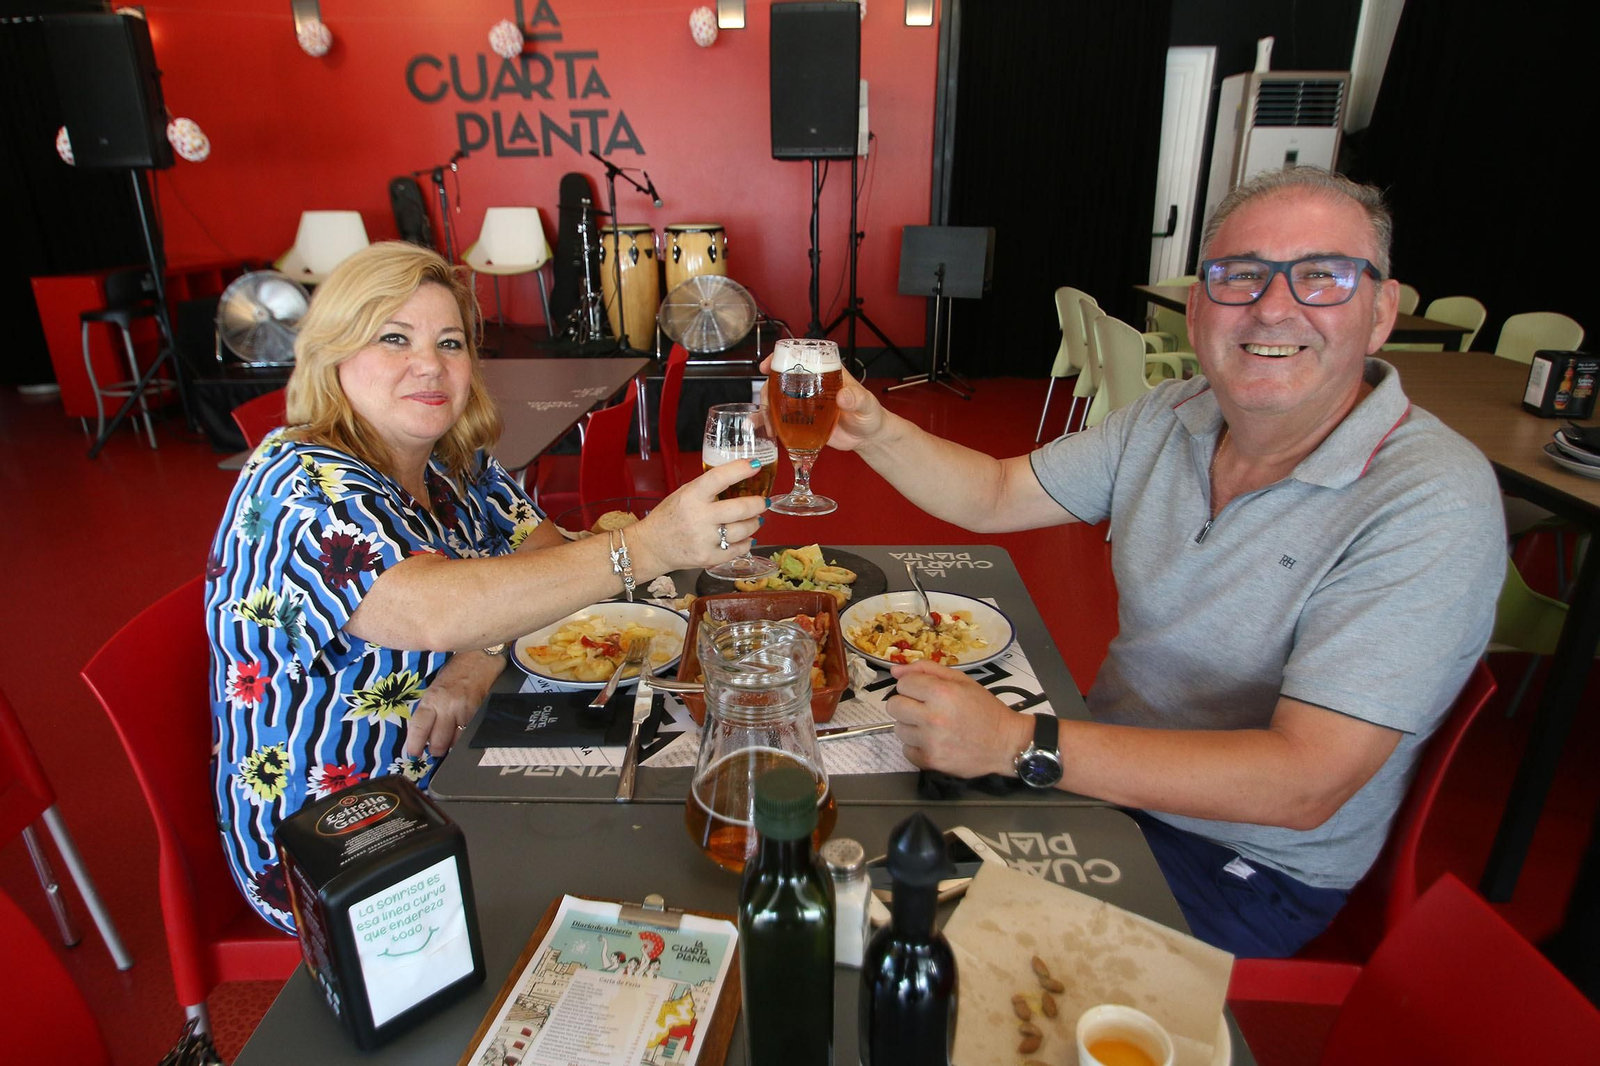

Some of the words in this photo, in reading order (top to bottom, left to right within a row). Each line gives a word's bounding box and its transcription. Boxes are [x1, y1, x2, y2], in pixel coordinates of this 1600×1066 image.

[514, 0, 562, 41] LA
[405, 50, 612, 104] CUARTA
[456, 109, 646, 158] PLANTA
[888, 552, 971, 560] PLANTA
[924, 569, 947, 578] LA
[326, 795, 387, 826] Estrella
[333, 803, 390, 829] Galicia
[975, 832, 1078, 856] PLAN
[1004, 858, 1121, 884] CUA
[356, 916, 380, 932] esa
[413, 883, 446, 907] curva
[359, 905, 375, 918] La
[376, 880, 425, 910] sonrisa
[427, 873, 441, 886] es
[363, 926, 387, 942] que
[389, 898, 444, 931] endereza
[671, 944, 708, 957] CUARTA
[694, 940, 703, 948] LA
[675, 952, 711, 965] PLANTA
